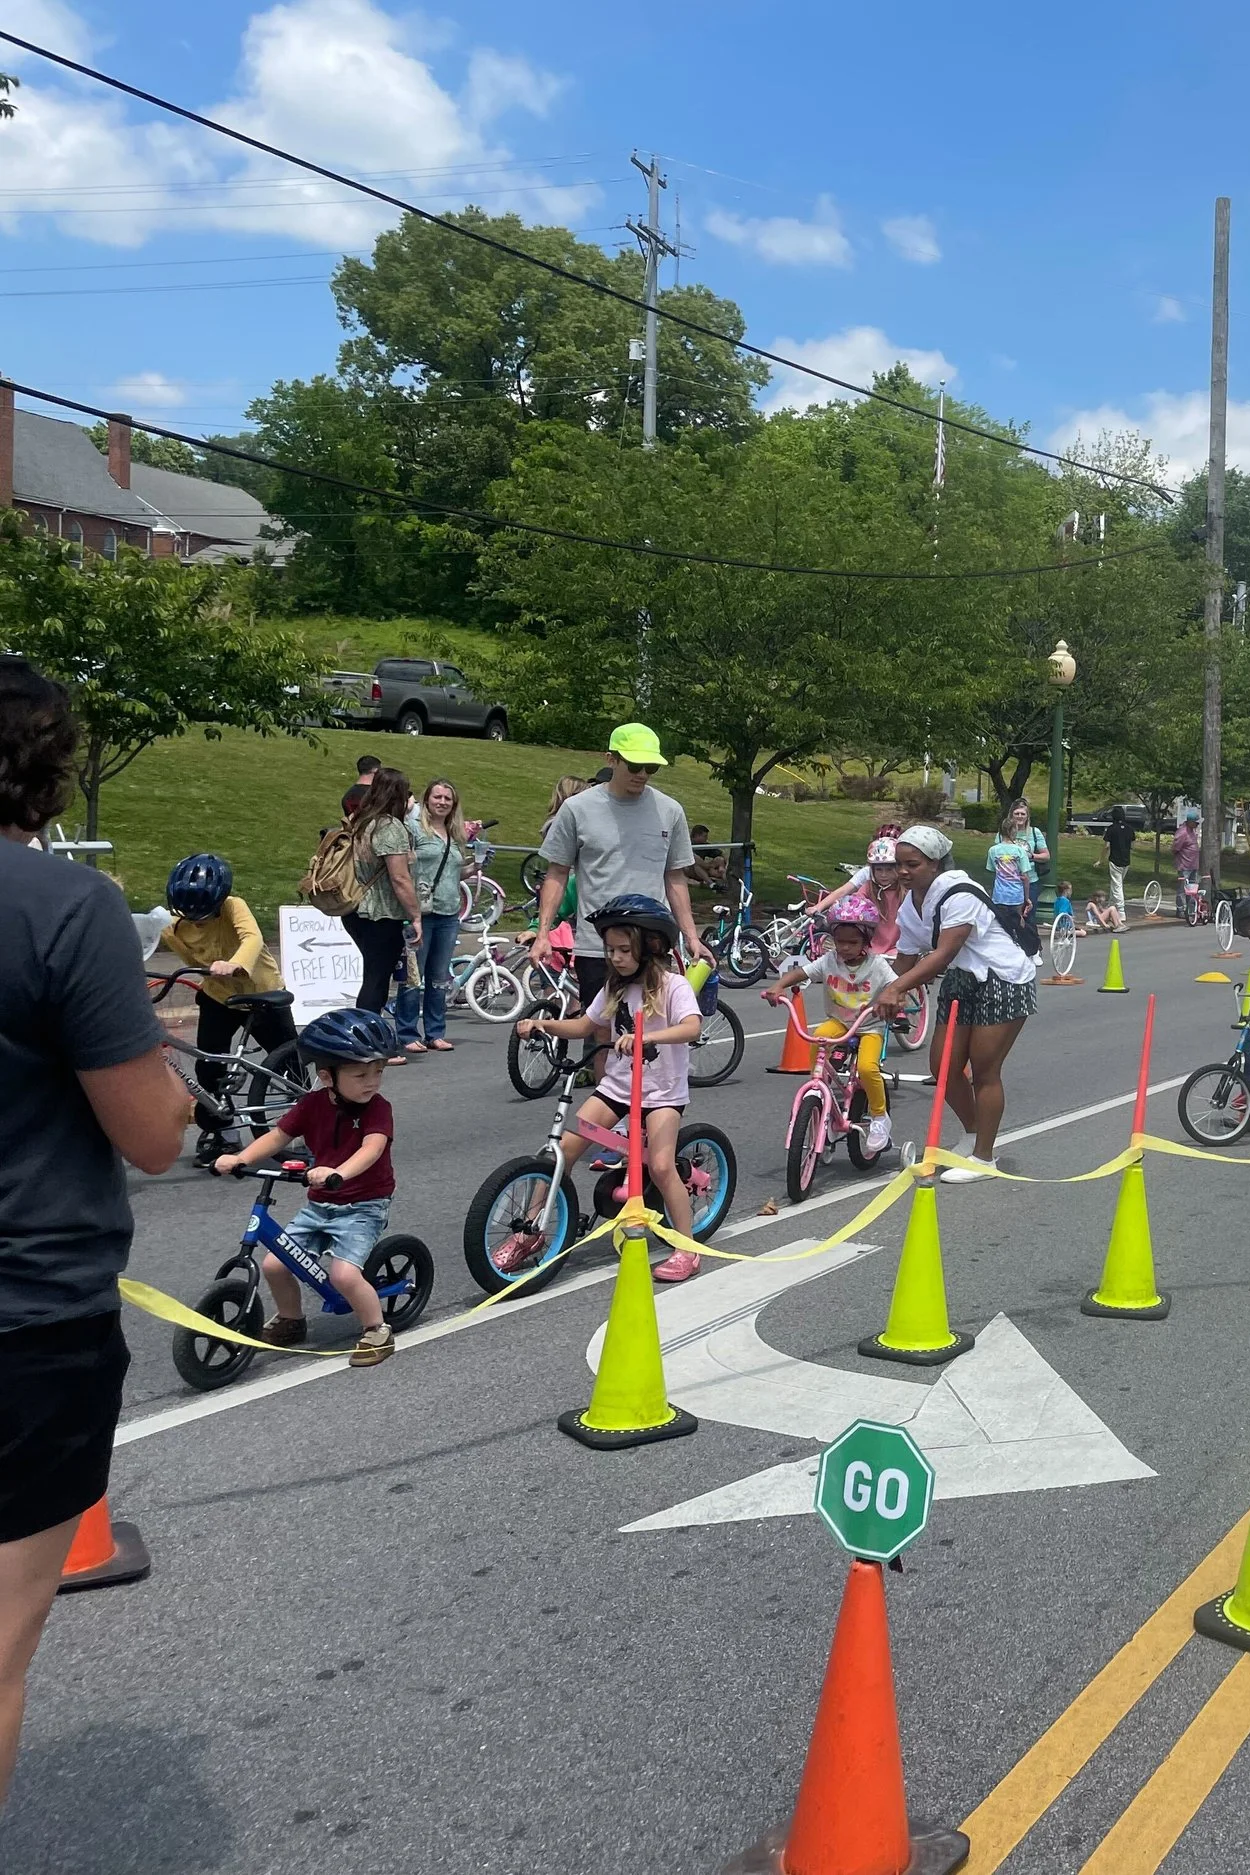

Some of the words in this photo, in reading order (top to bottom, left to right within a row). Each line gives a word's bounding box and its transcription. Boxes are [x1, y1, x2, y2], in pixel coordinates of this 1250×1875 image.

[291, 956, 327, 981] FREE
[276, 1233, 327, 1284] STRIDER
[843, 1460, 910, 1520] GO
